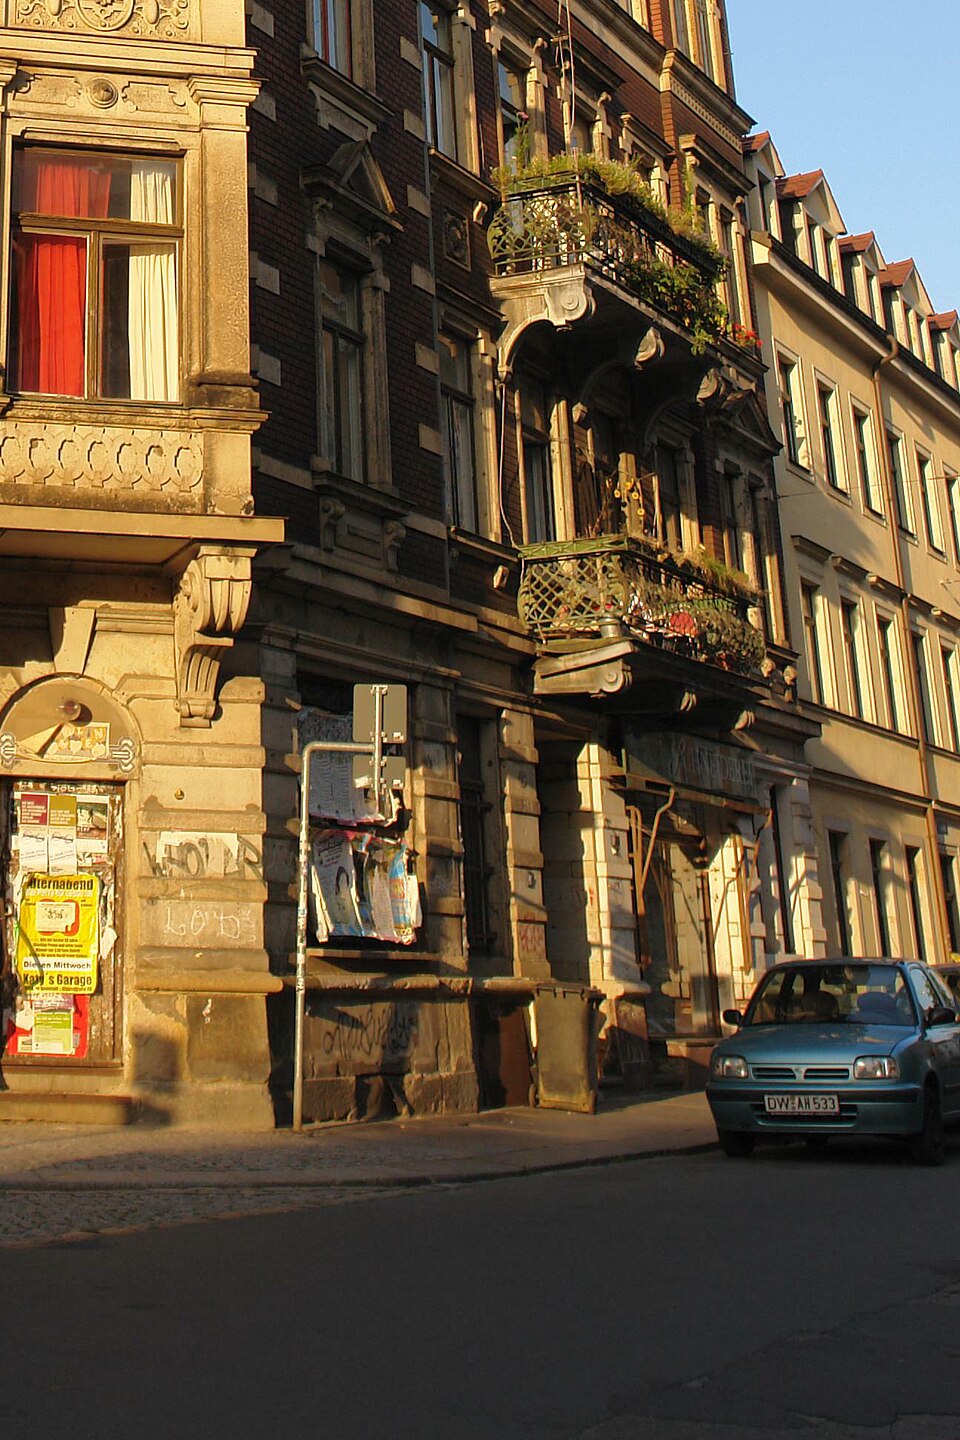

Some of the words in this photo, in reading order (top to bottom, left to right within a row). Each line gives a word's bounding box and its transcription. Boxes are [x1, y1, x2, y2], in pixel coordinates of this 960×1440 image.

[57, 974, 92, 987] Garage
[767, 1097, 789, 1110] DW
[797, 1097, 810, 1110] AH
[813, 1097, 836, 1110] 533
